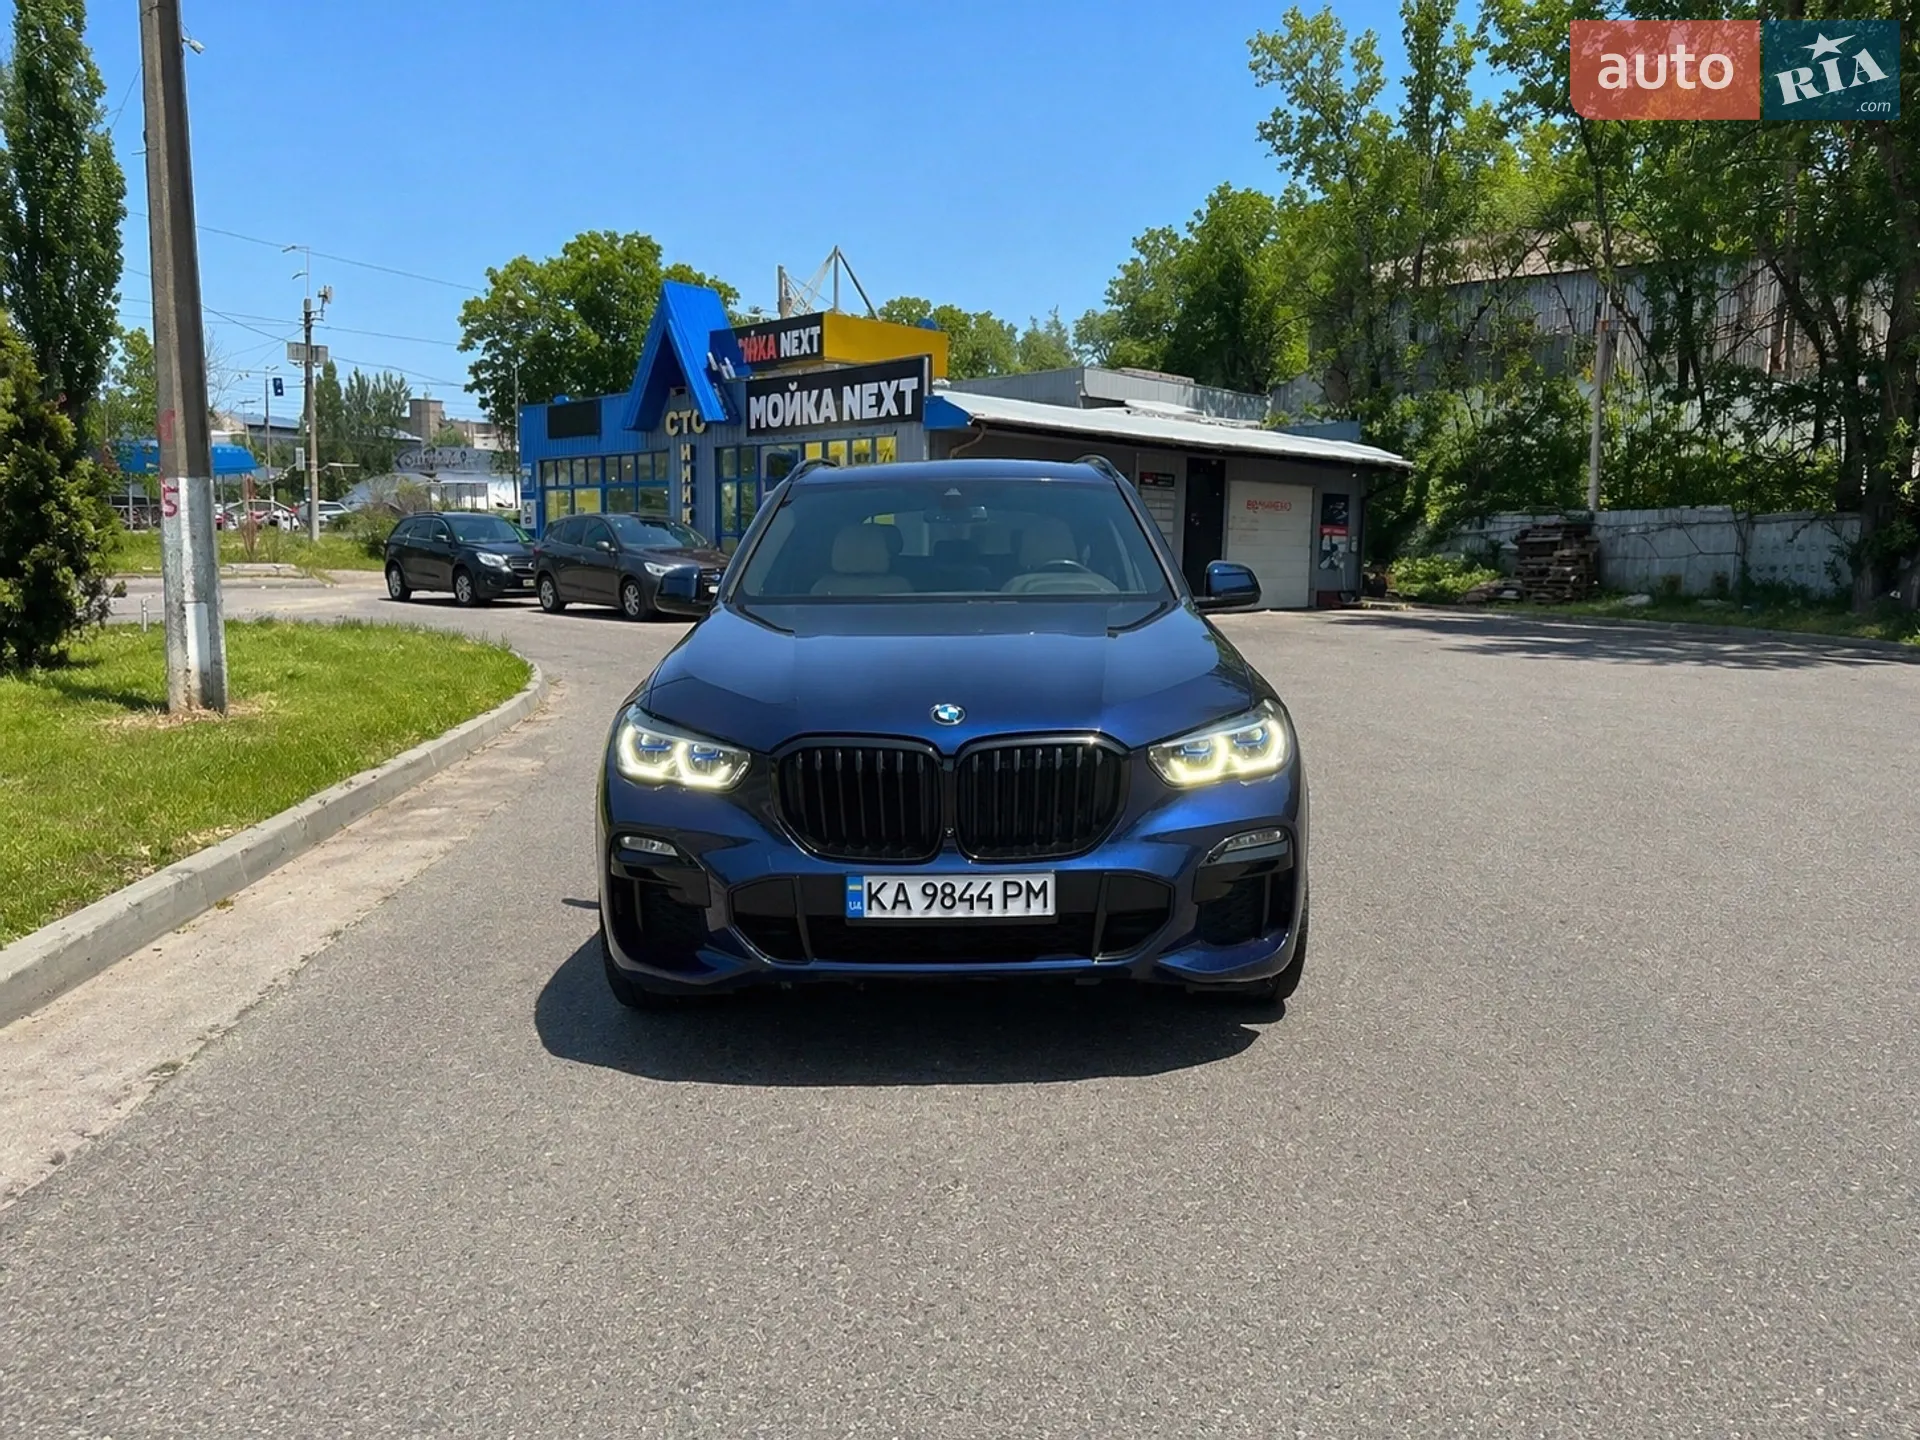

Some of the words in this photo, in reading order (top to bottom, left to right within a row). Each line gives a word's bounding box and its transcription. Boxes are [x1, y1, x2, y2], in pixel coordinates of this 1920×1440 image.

[780, 325, 821, 358] NEXT
[749, 381, 837, 429] МОЙКА
[843, 377, 919, 421] NEXT
[866, 881, 912, 911] KA
[920, 881, 993, 911] 9844
[1002, 880, 1049, 910] PM
